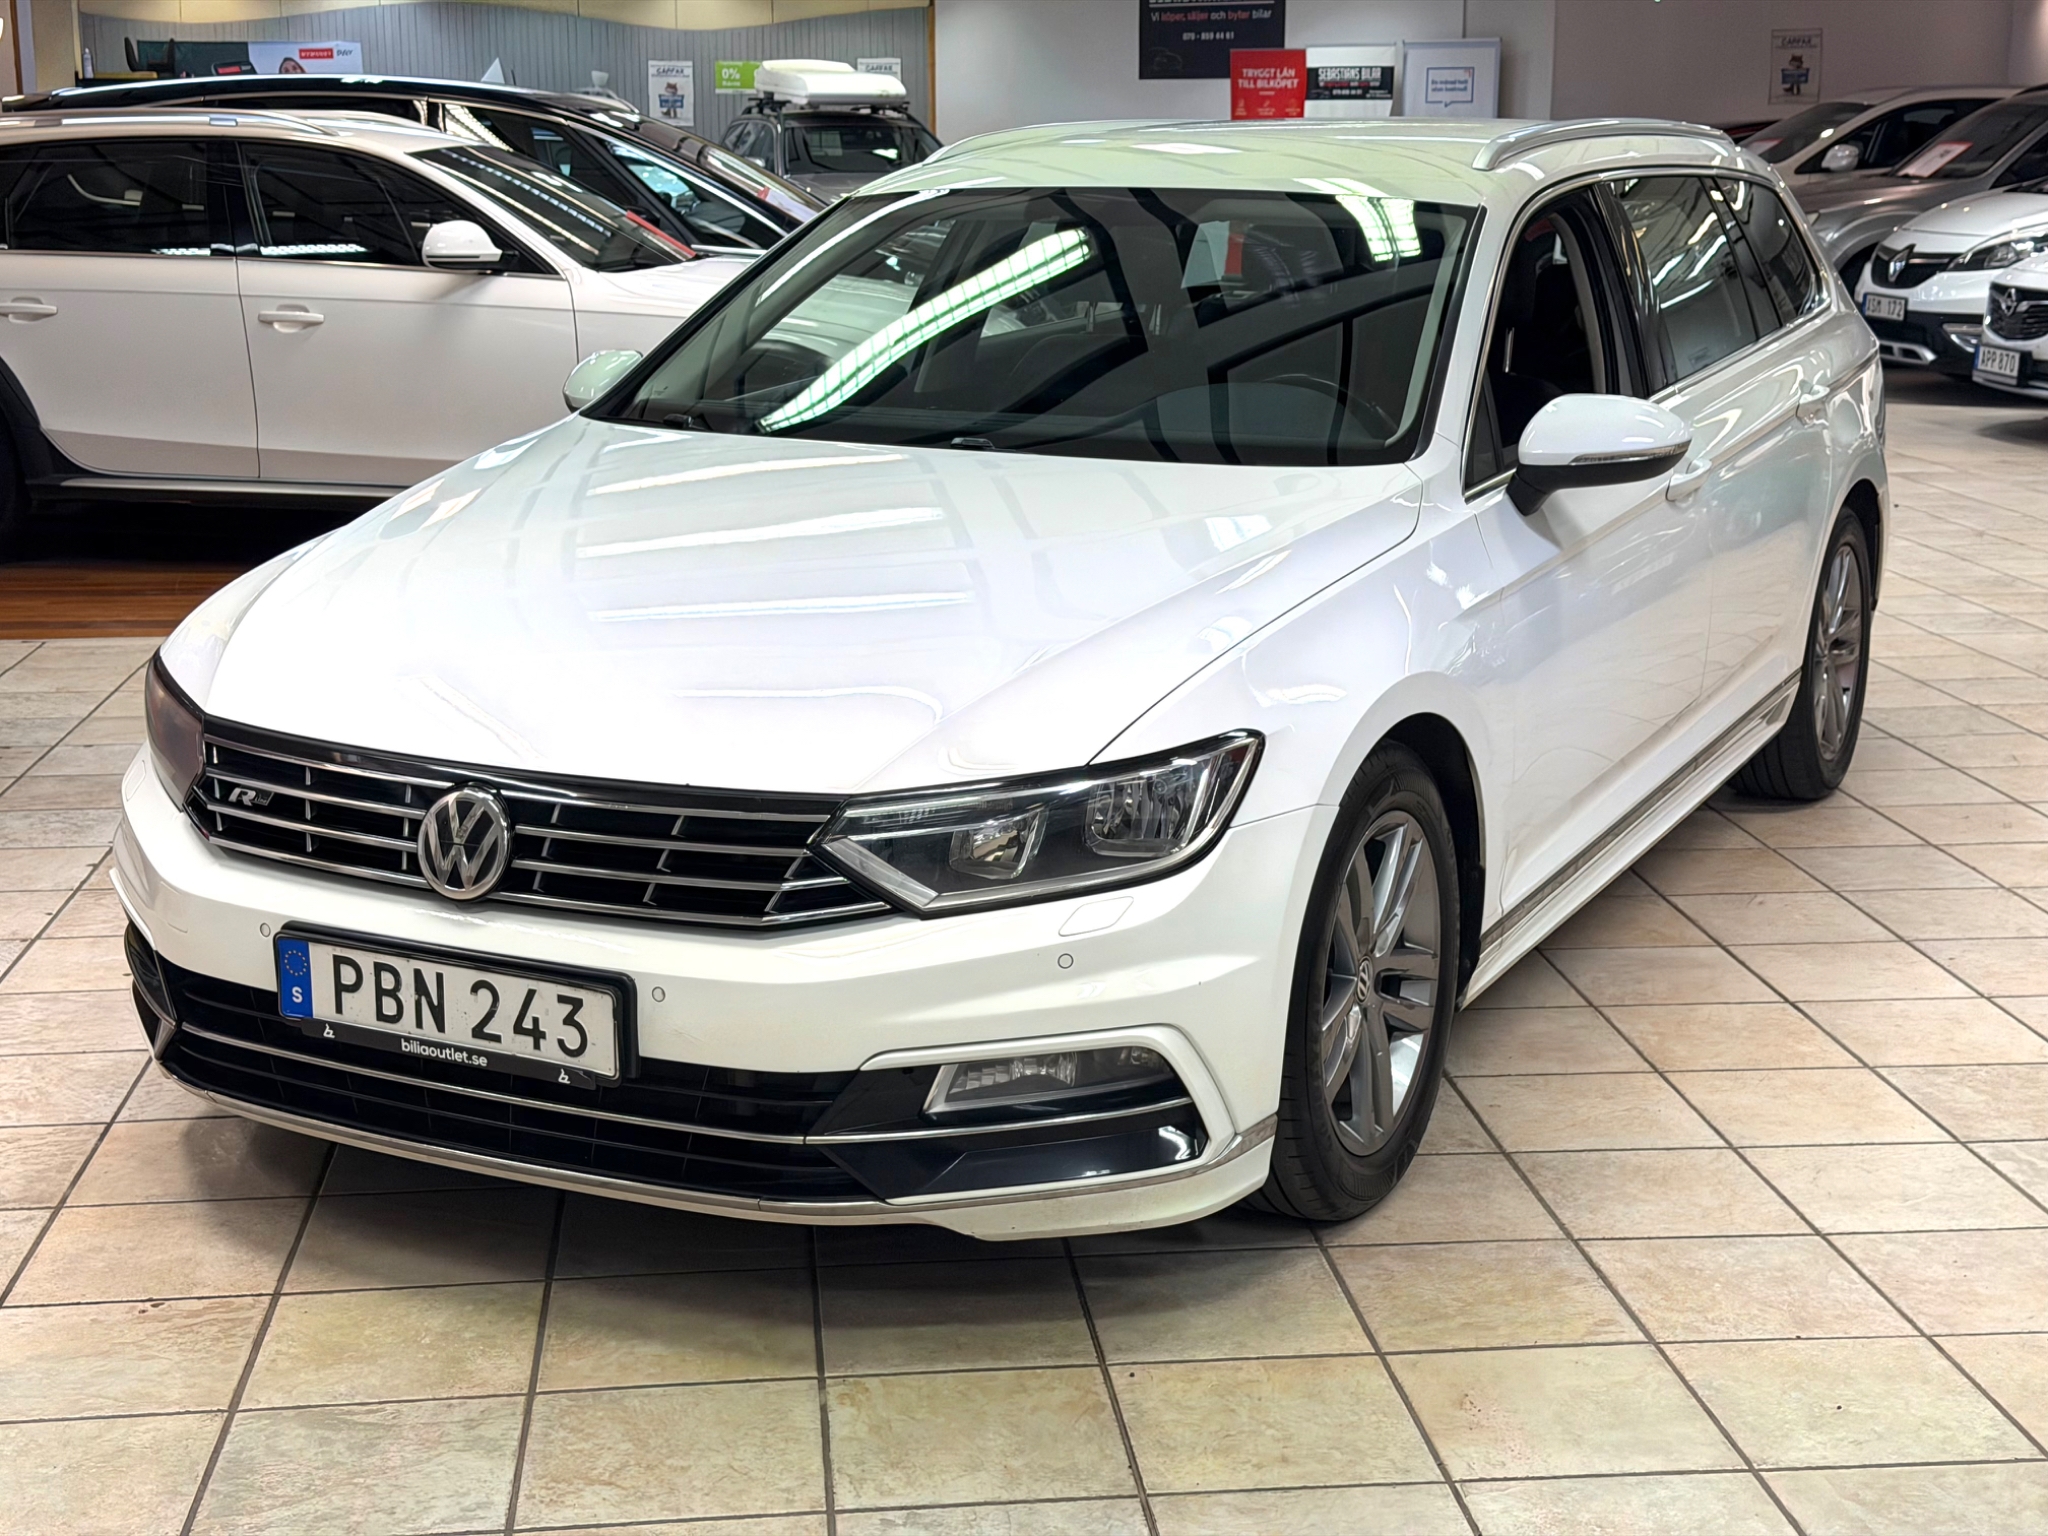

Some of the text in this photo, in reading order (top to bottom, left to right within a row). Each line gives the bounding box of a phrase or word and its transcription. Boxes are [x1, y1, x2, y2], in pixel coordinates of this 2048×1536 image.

[721, 68, 741, 80] 0%
[1242, 67, 1296, 79] TRYGGT LÅN
[1237, 78, 1300, 89] TILL BILKÖPET
[1886, 299, 1904, 318] 172
[1980, 348, 2017, 374] APP 870
[292, 953, 589, 1059] S PBN 243
[401, 1037, 489, 1067] biliaoutlet.se
